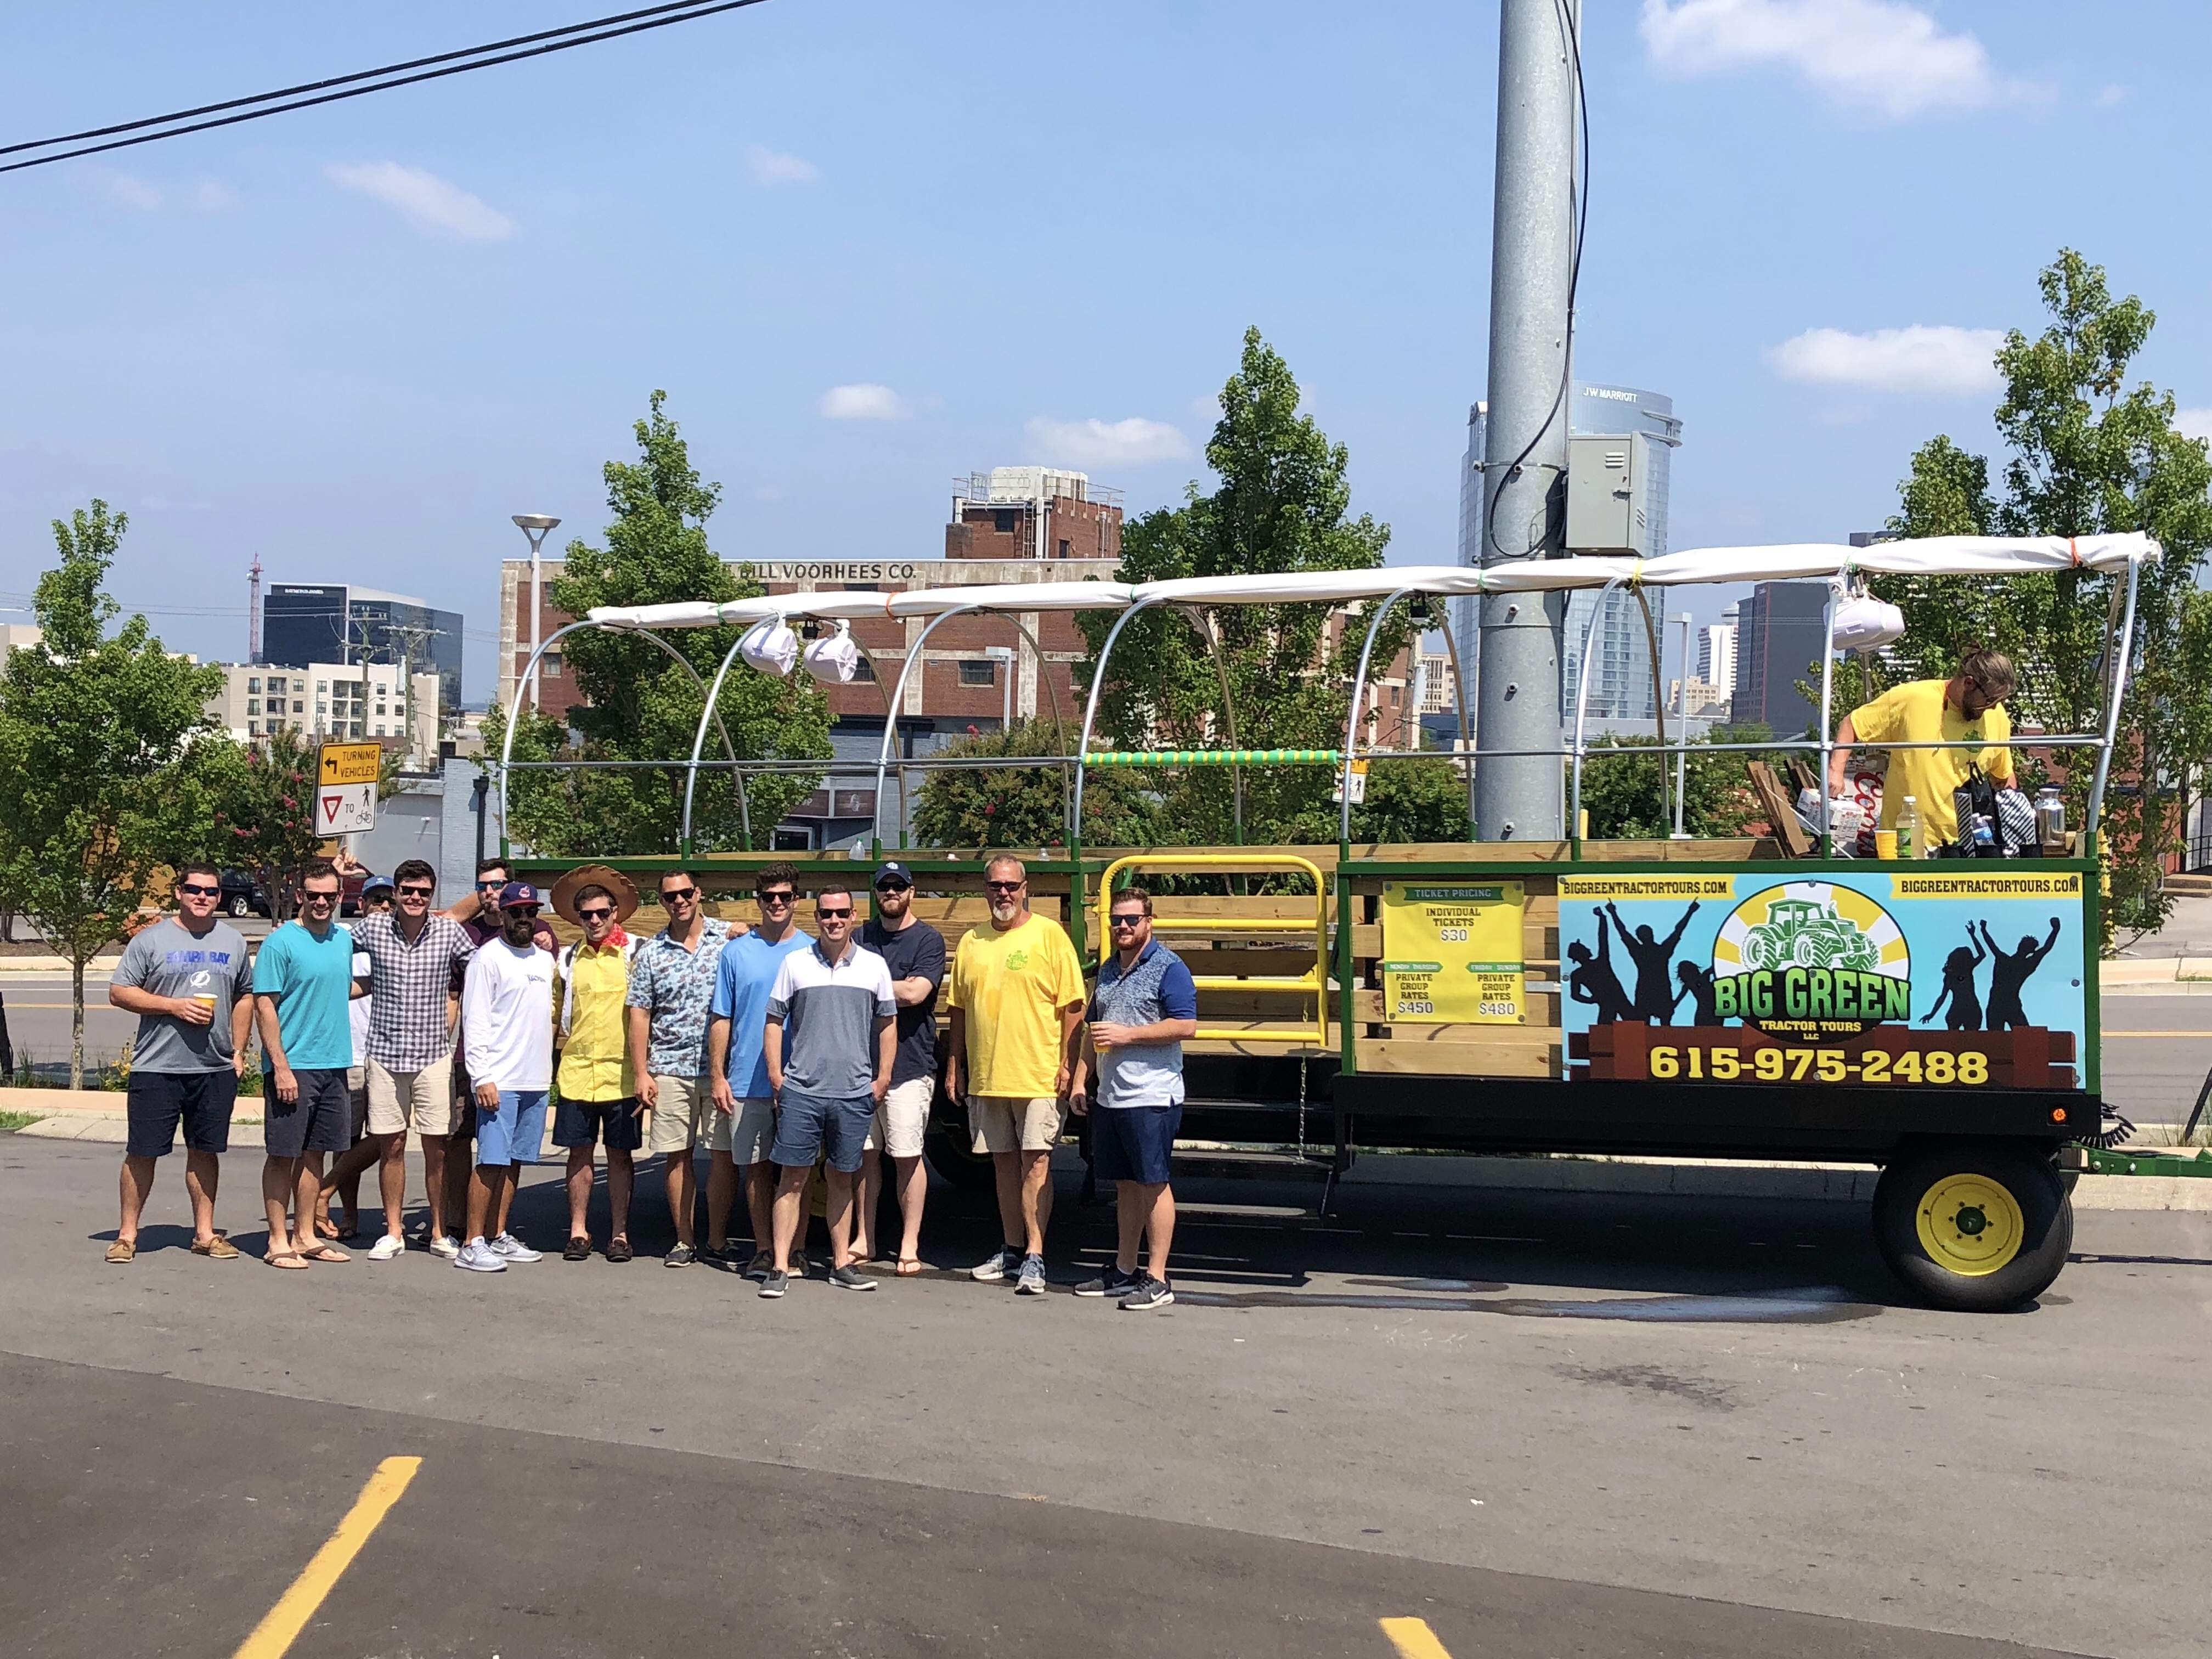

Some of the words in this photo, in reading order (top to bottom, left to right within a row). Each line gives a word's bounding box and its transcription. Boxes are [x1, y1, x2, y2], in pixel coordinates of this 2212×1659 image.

[1583, 387, 1599, 397] JW
[1599, 388, 1638, 403] MARRIOTT
[782, 564, 882, 579] VOORHEES
[888, 564, 917, 579] CO.
[342, 749, 376, 761] TURNING
[340, 766, 375, 777] VEHICLES
[345, 803, 354, 814] TO
[1563, 881, 1728, 894] BIGGREENTRACTORTOURS.COM
[1901, 879, 2079, 893] BIGGREENTRACTORTOURS.COM
[1414, 889, 1449, 898] TICKET
[1452, 889, 1492, 898] PRICING
[1426, 907, 1481, 917] INDIVIDUAL
[1432, 918, 1475, 927] TICKETS
[1441, 929, 1468, 941] $30
[209, 951, 230, 964] BAY
[1482, 983, 1511, 991] GROUP
[1713, 970, 1774, 1017] BIG
[1785, 967, 1910, 1019] GREEN
[1482, 992, 1511, 1001] RATES
[1398, 1002, 1434, 1014] $450
[1479, 1002, 1515, 1015] $480
[1759, 1020, 1817, 1031] TRACTOR
[1819, 1021, 1861, 1032] TOURS
[1650, 1046, 1988, 1085] 615-975-2488
